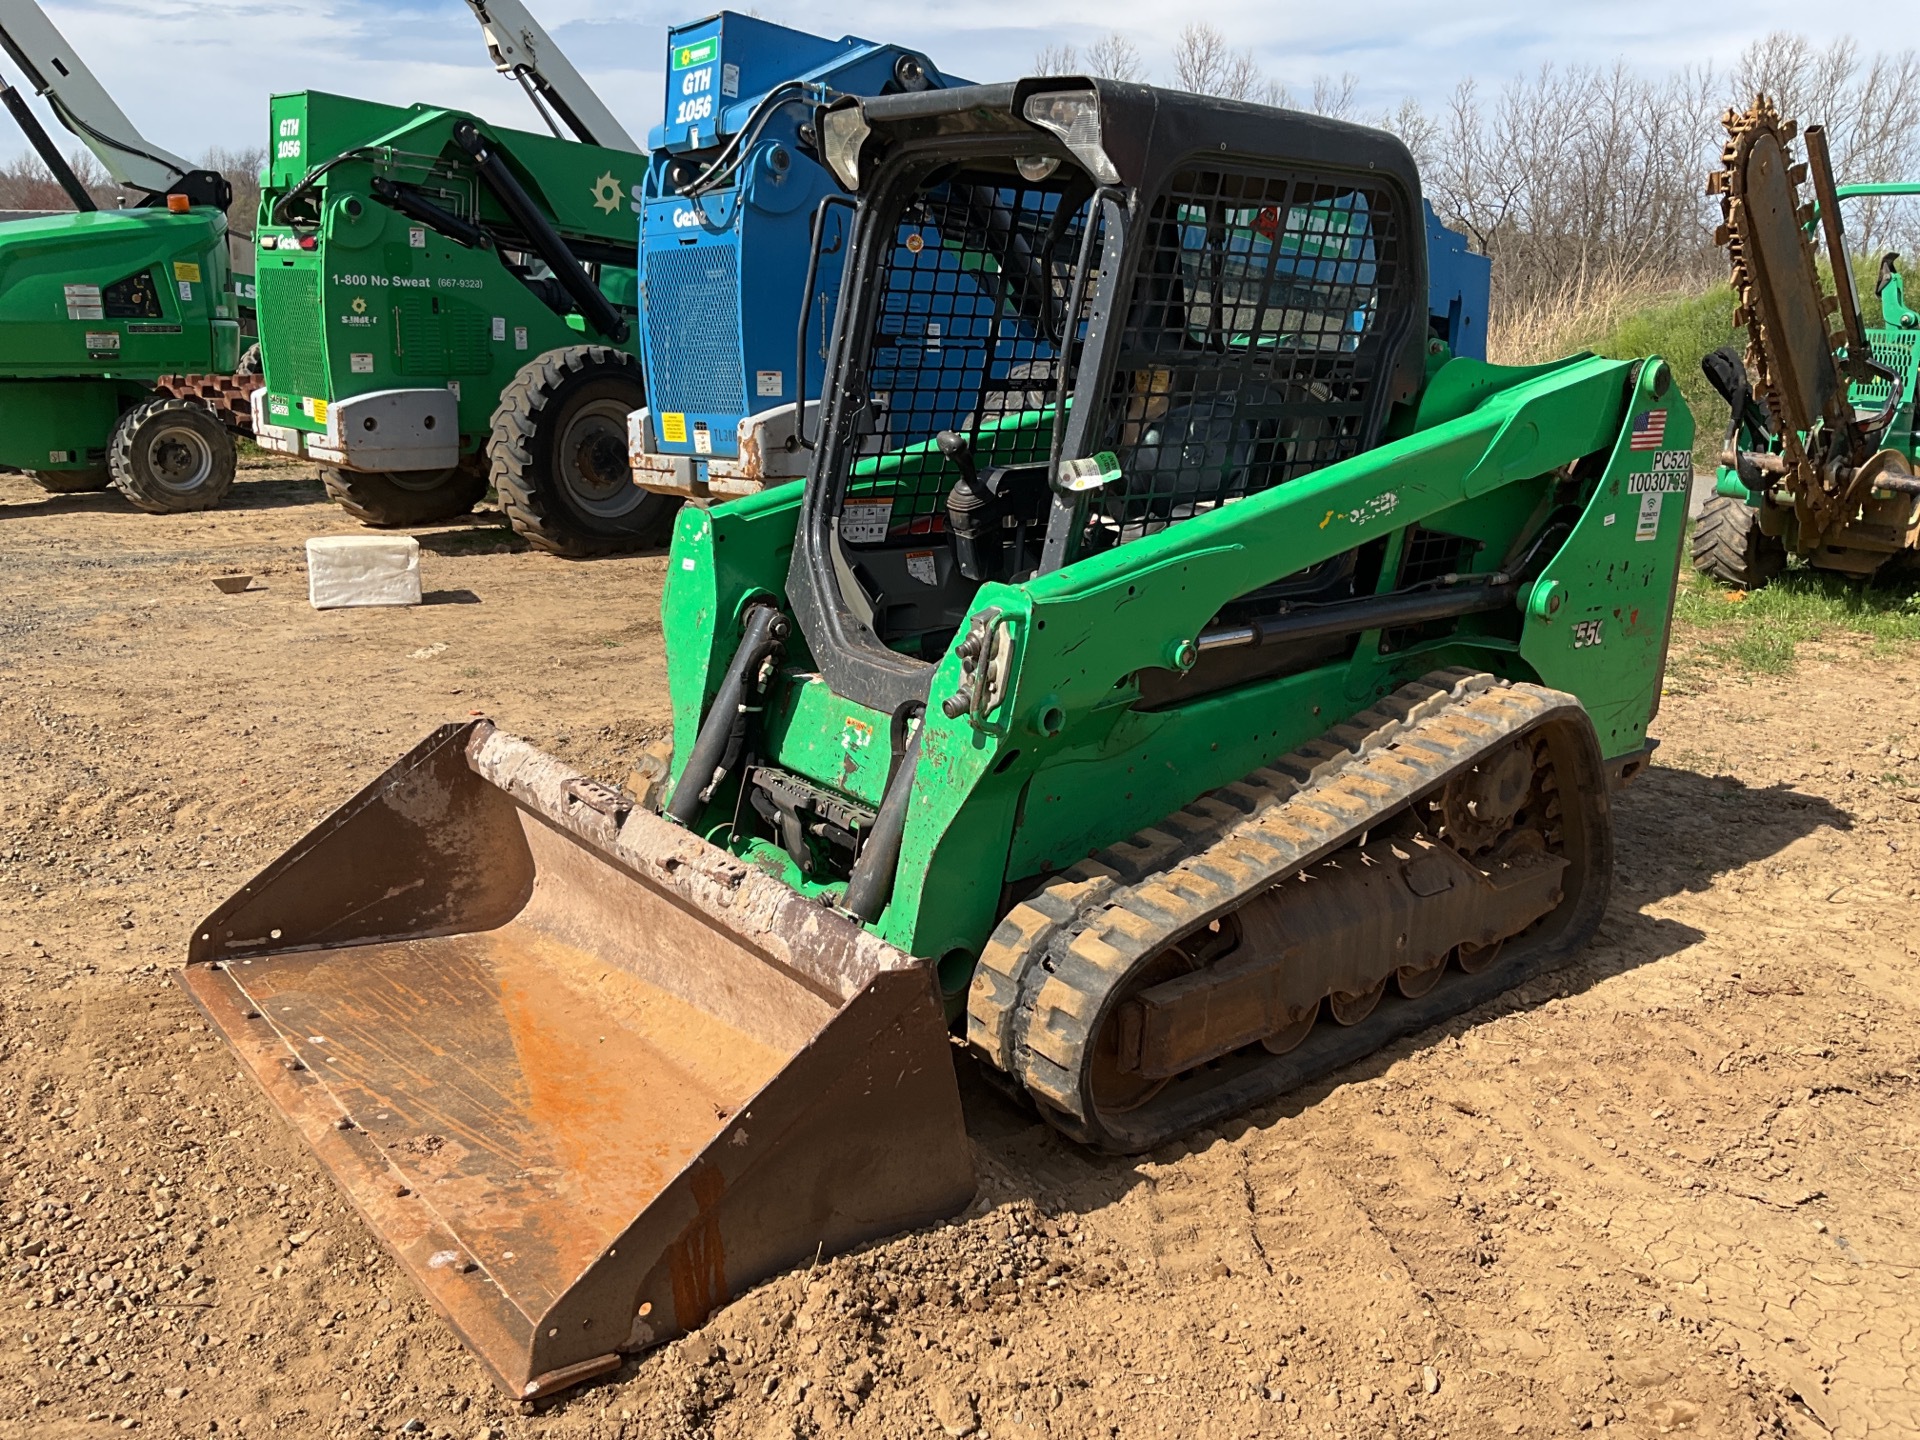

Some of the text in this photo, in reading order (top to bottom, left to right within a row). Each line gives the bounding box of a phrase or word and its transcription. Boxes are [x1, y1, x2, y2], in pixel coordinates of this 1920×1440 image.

[682, 66, 712, 96] GTH
[675, 94, 712, 125] 1056
[280, 118, 300, 137] GTH
[277, 140, 301, 159] 1056
[673, 208, 707, 229] Genie
[332, 274, 368, 286] 1-800
[371, 275, 389, 287] No
[392, 275, 431, 288] Sweat
[1653, 451, 1691, 470] PC520
